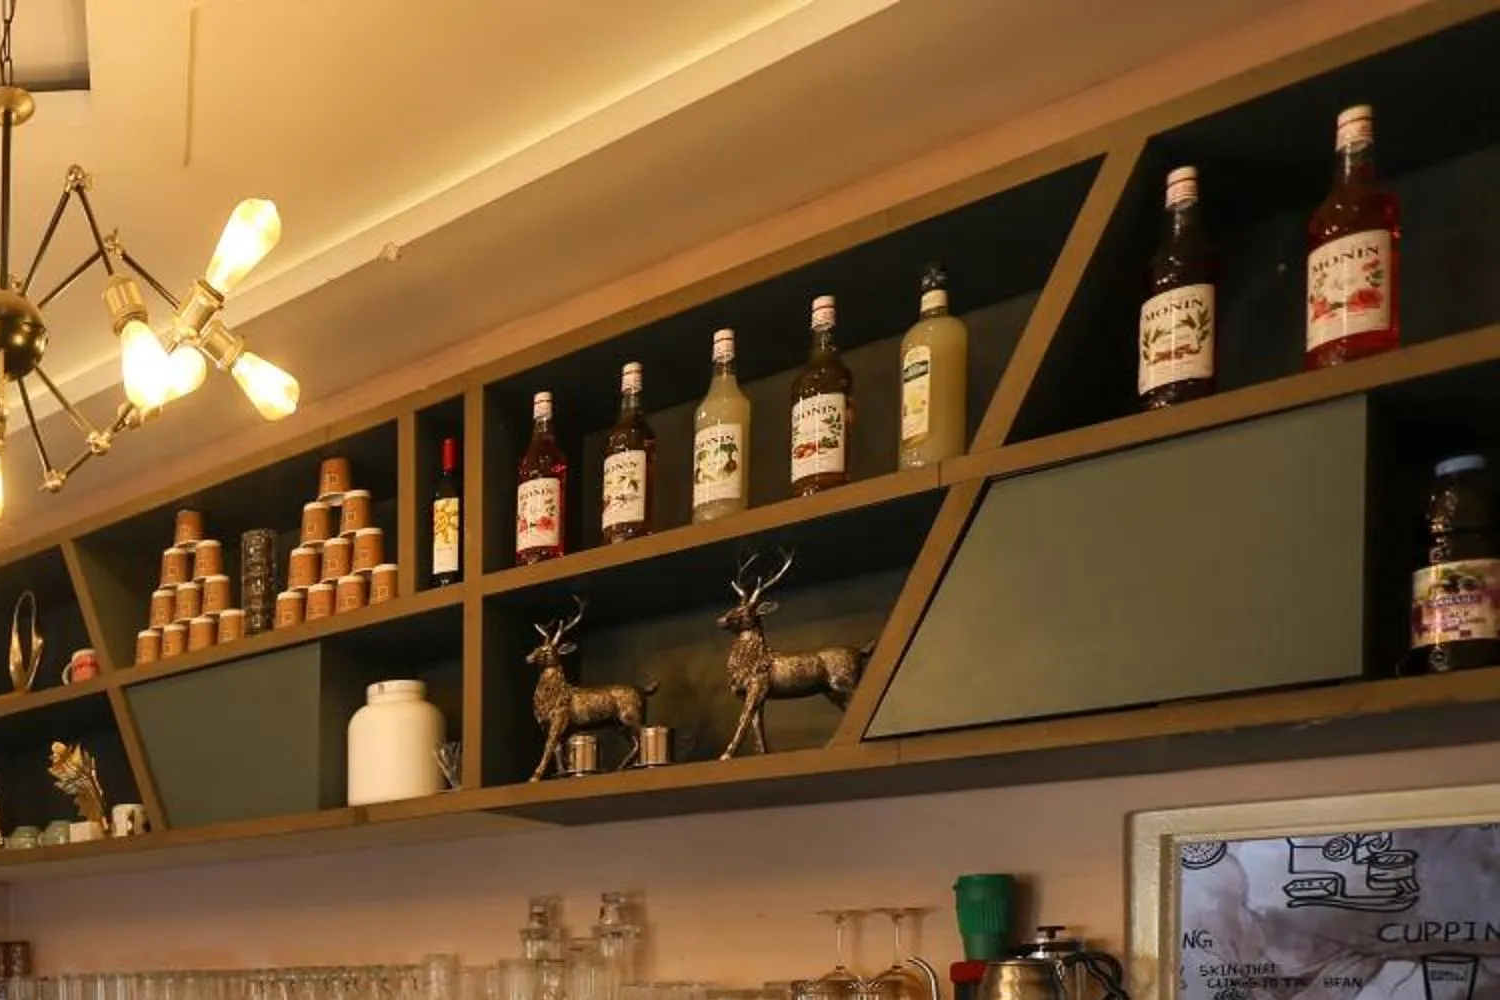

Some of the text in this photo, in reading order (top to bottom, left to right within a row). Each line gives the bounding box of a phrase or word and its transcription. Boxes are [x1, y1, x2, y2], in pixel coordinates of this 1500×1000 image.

[1312, 244, 1380, 274] MONIN
[1144, 298, 1204, 321] MONIN
[1377, 920, 1500, 944] CUPPIN
